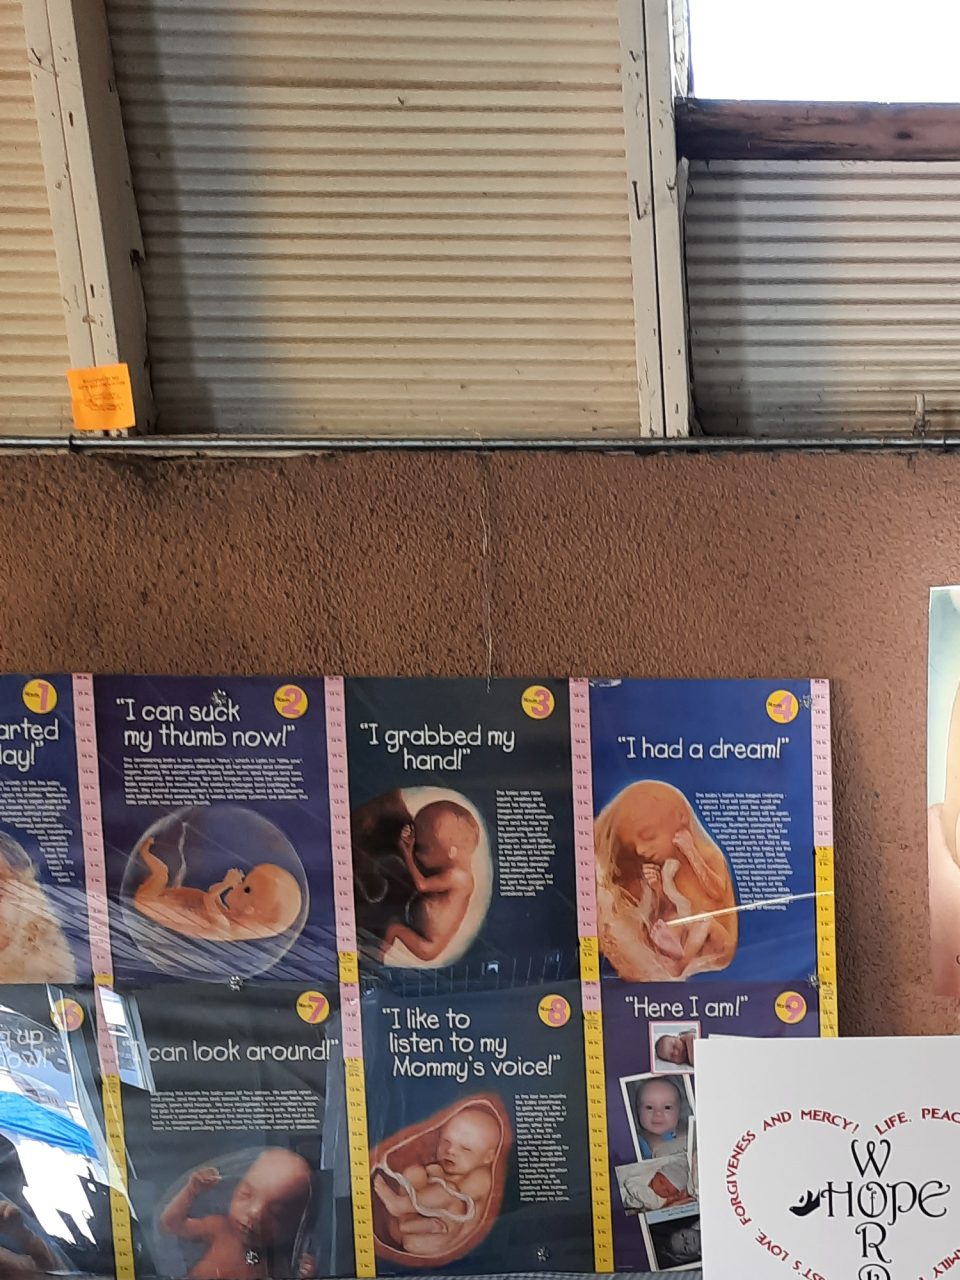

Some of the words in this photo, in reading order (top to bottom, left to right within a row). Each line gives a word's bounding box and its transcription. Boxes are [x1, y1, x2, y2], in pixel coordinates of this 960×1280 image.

[116, 697, 136, 721] "I
[141, 705, 184, 729] can
[189, 697, 241, 729] suck
[123, 730, 153, 753] my
[158, 722, 227, 747] thumb
[232, 724, 296, 748] now!"
[359, 722, 379, 746] "I
[384, 723, 482, 753] grabbed
[487, 730, 515, 753] my
[617, 736, 637, 759] "I
[641, 735, 683, 759] had
[688, 743, 704, 760] a
[709, 736, 790, 760] dream!"
[403, 747, 471, 771] hand!"
[382, 1007, 401, 1035] "I
[406, 1006, 440, 1036] like
[445, 1007, 471, 1036] to
[624, 996, 686, 1019] "Here
[688, 996, 700, 1018] I
[704, 994, 751, 1019] am!"
[149, 1046, 188, 1062] can
[192, 1039, 241, 1062] look
[246, 1039, 339, 1062] around!"
[389, 1031, 444, 1059] listen
[448, 1031, 475, 1060] to
[479, 1037, 507, 1059] my
[393, 1055, 486, 1083] Mommy's
[490, 1052, 561, 1076] voice!"
[762, 1110, 792, 1132] AND
[800, 1109, 860, 1135] MERCY!
